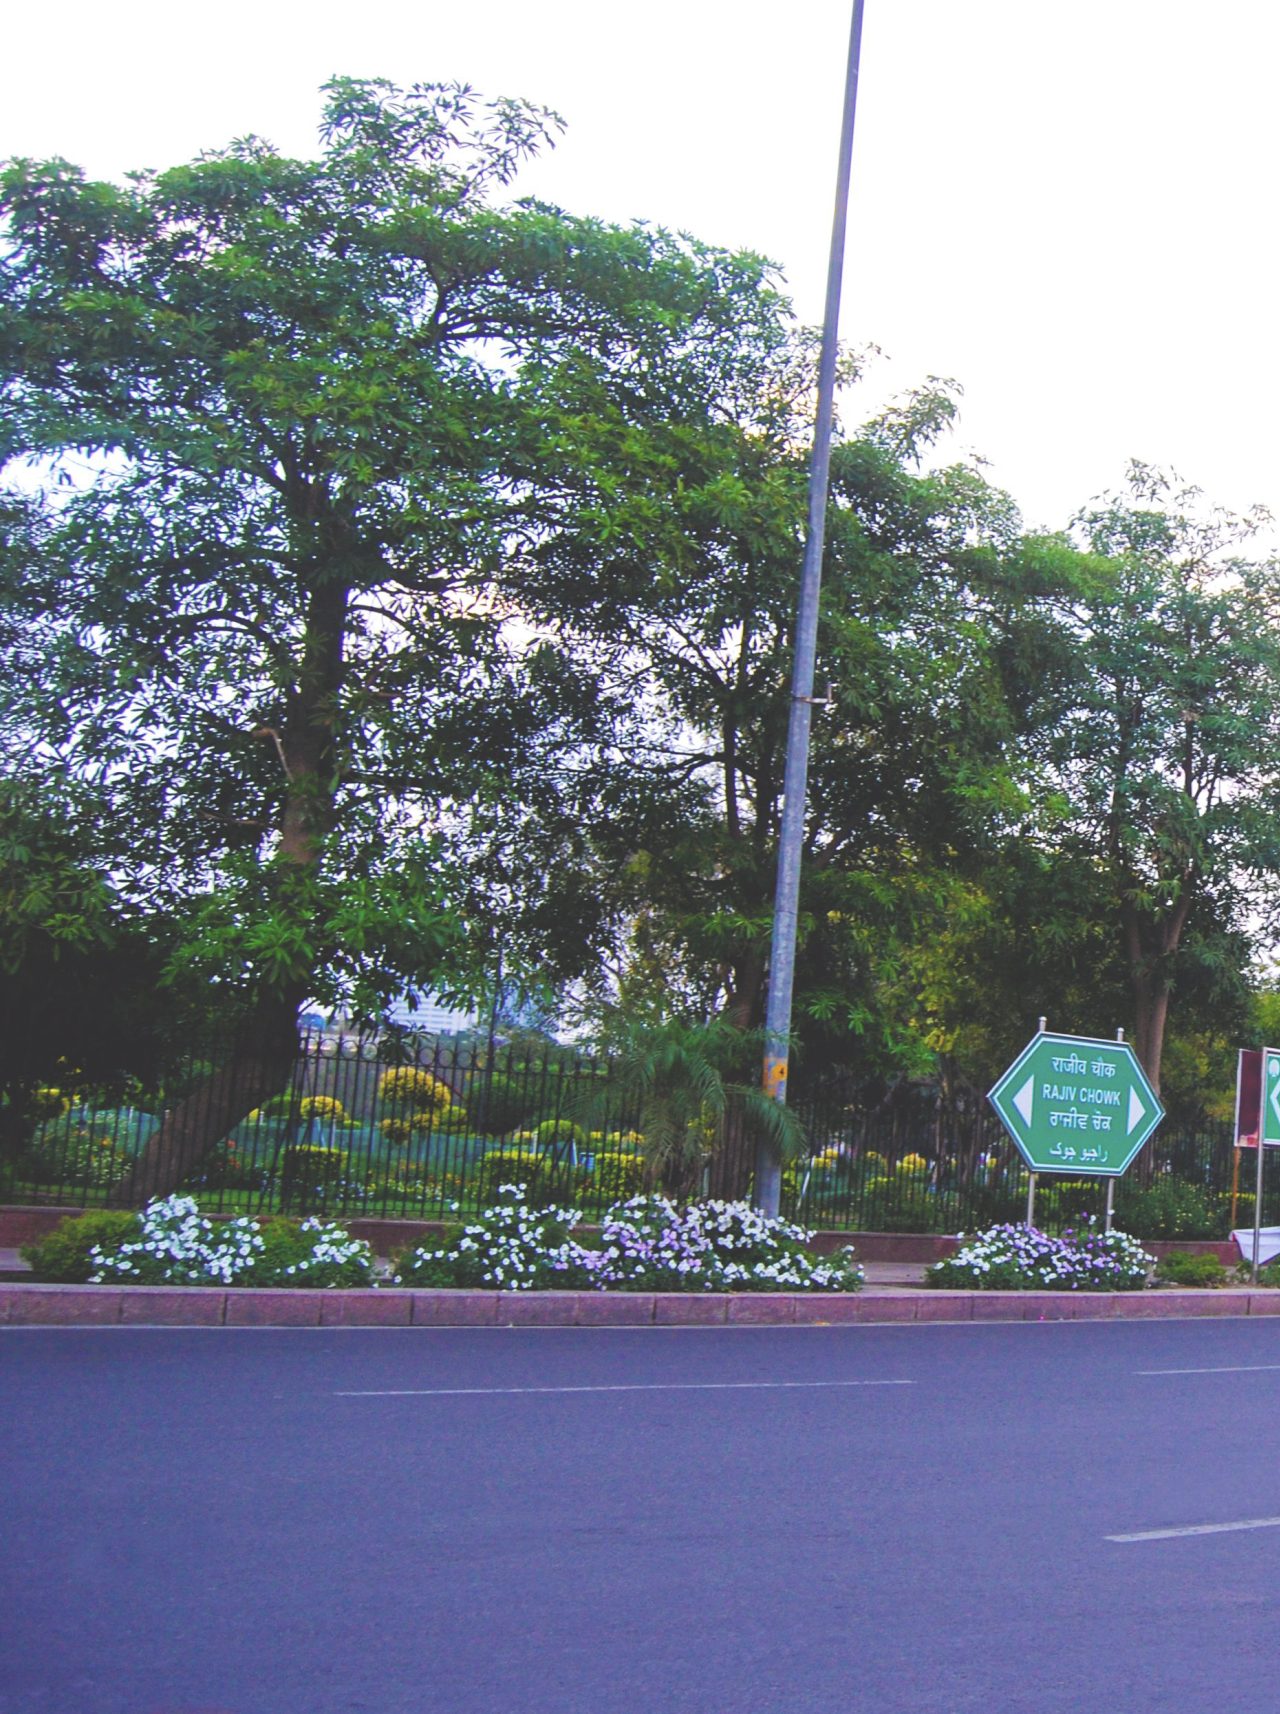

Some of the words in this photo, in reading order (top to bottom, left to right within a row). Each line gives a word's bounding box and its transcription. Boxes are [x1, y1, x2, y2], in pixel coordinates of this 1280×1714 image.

[1051, 1053, 1087, 1074] राजीव
[1091, 1056, 1116, 1077] चौक
[1043, 1084, 1076, 1101] RAJIV
[1079, 1088, 1121, 1106] CHOWK
[1050, 1107, 1089, 1129] ਰਾਜੀਵ
